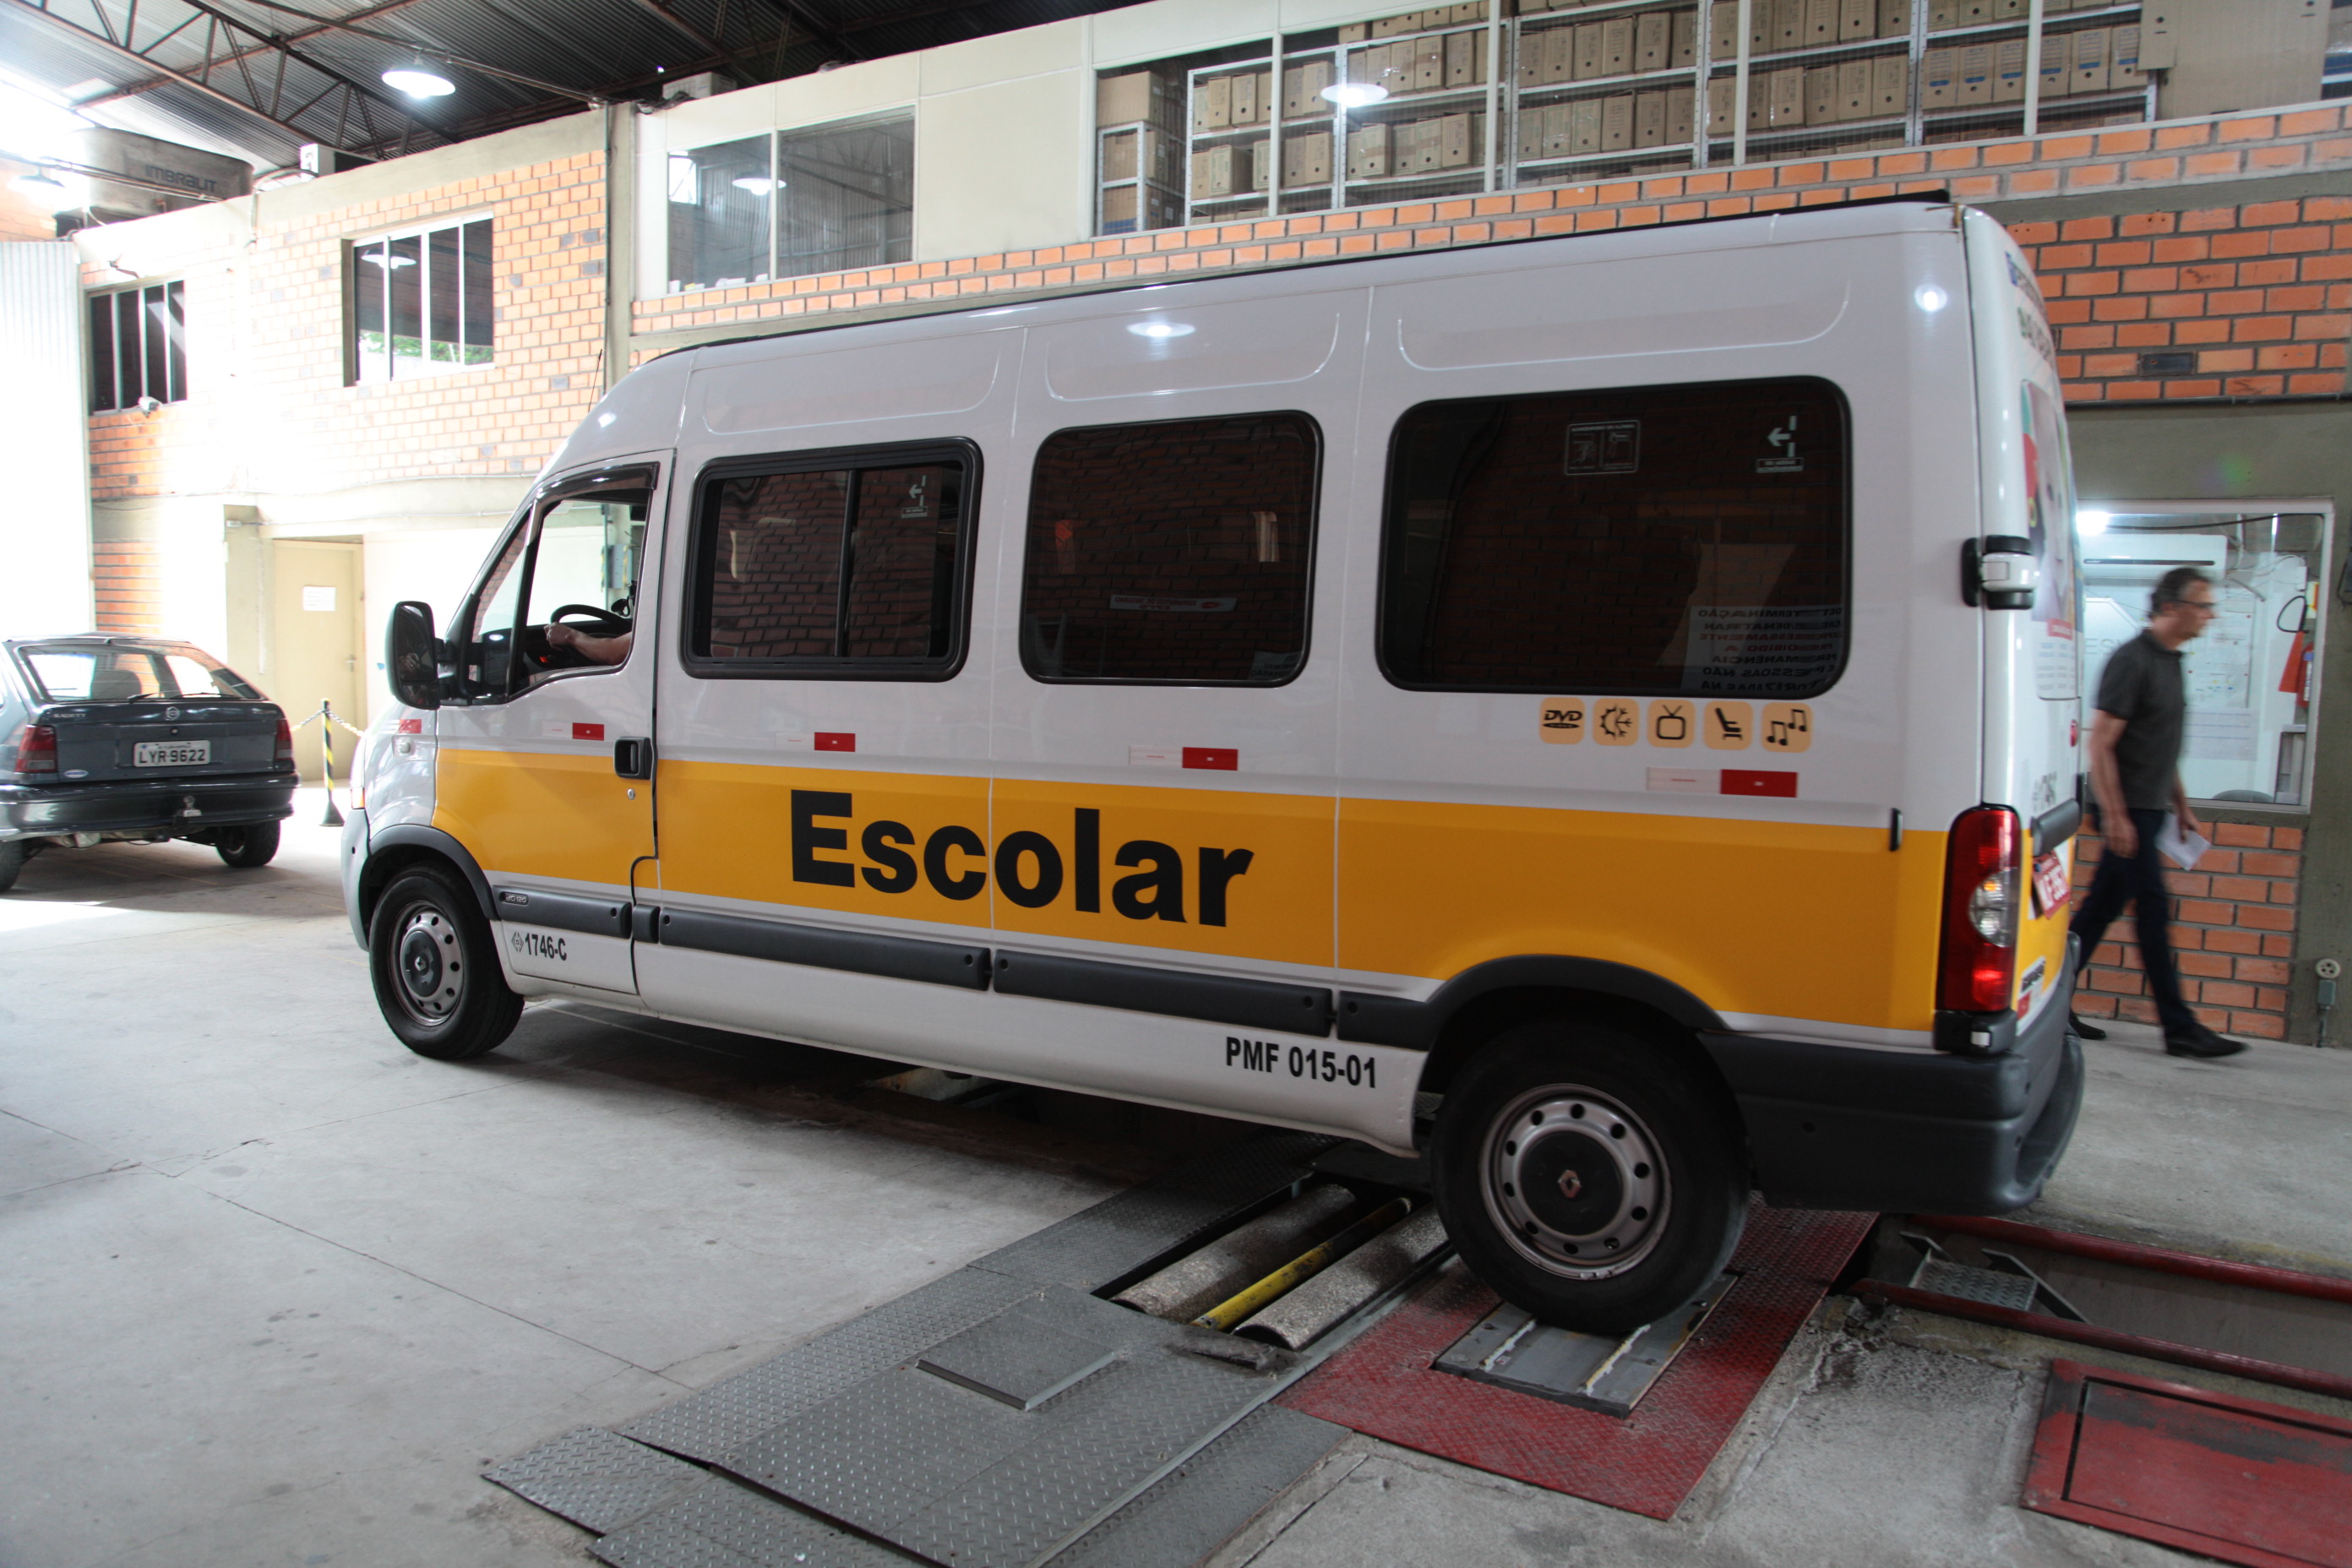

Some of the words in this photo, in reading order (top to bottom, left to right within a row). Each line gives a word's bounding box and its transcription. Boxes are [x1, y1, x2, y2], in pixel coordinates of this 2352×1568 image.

[1544, 710, 1583, 721] DVD
[791, 789, 1255, 928] Escolar
[525, 932, 567, 961] 1746-C
[1226, 1037, 1279, 1073] PMF
[1288, 1046, 1376, 1089] 015-01
